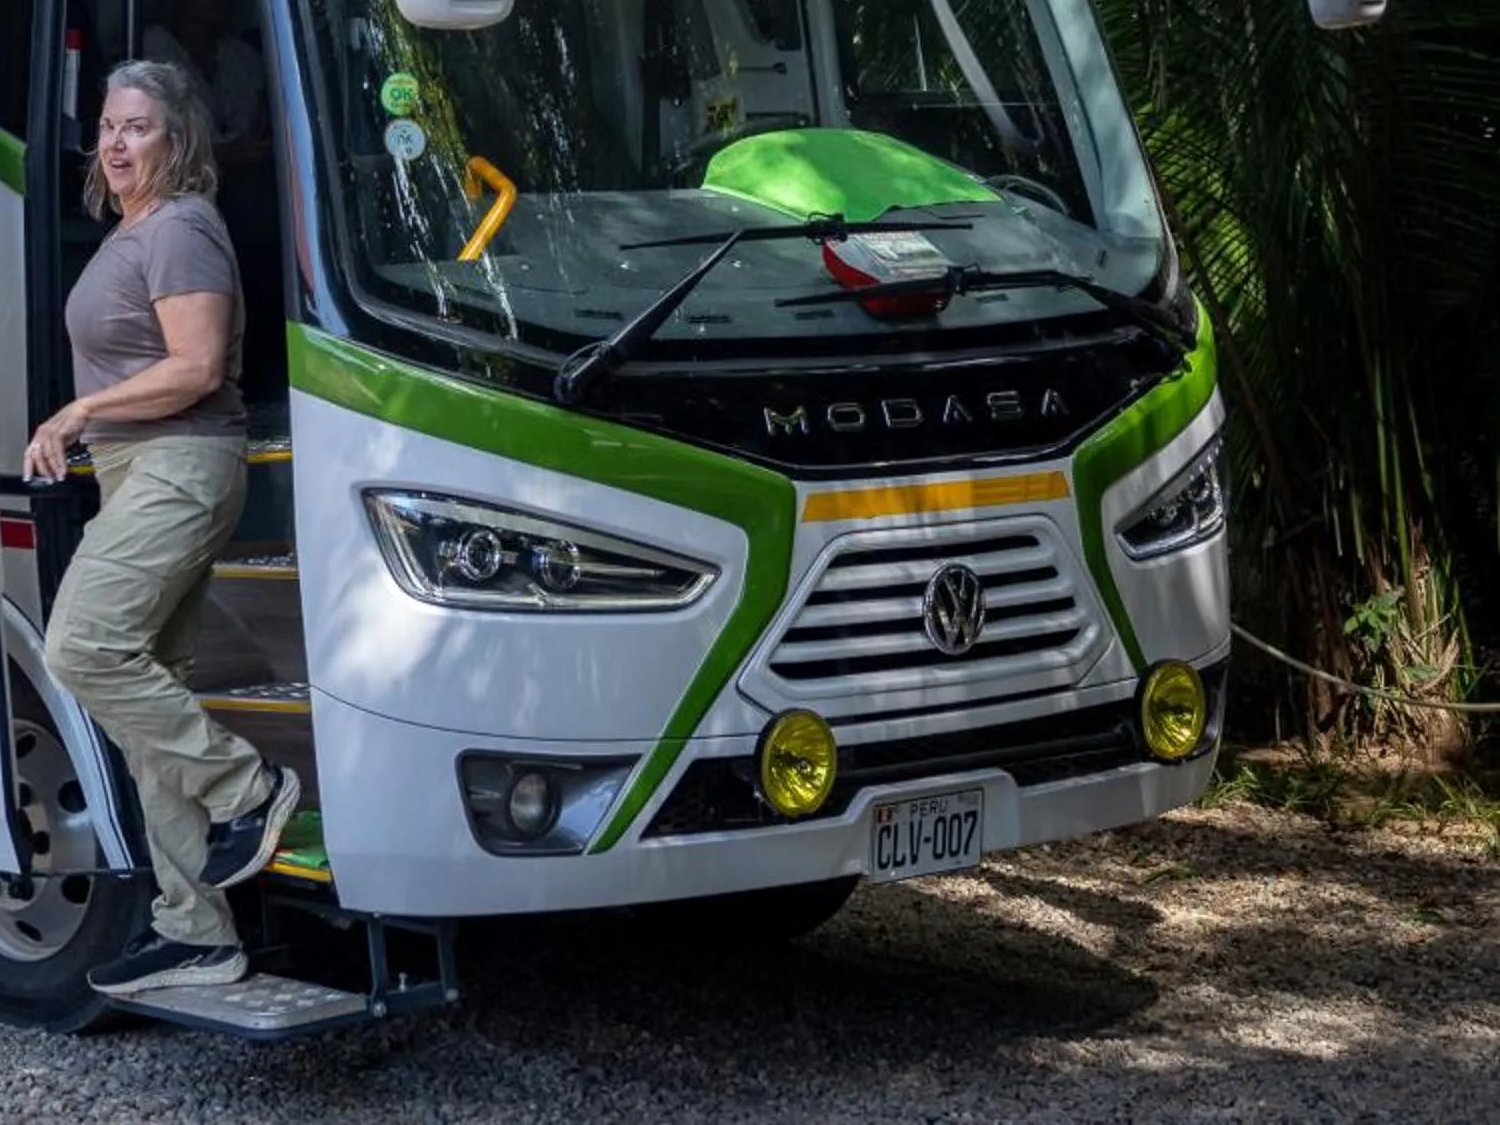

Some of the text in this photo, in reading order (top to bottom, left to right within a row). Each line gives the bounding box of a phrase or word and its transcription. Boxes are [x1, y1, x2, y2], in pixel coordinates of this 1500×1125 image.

[762, 387, 1070, 436] MODASA
[909, 800, 950, 817] PERU
[877, 810, 978, 871] CLV-007
